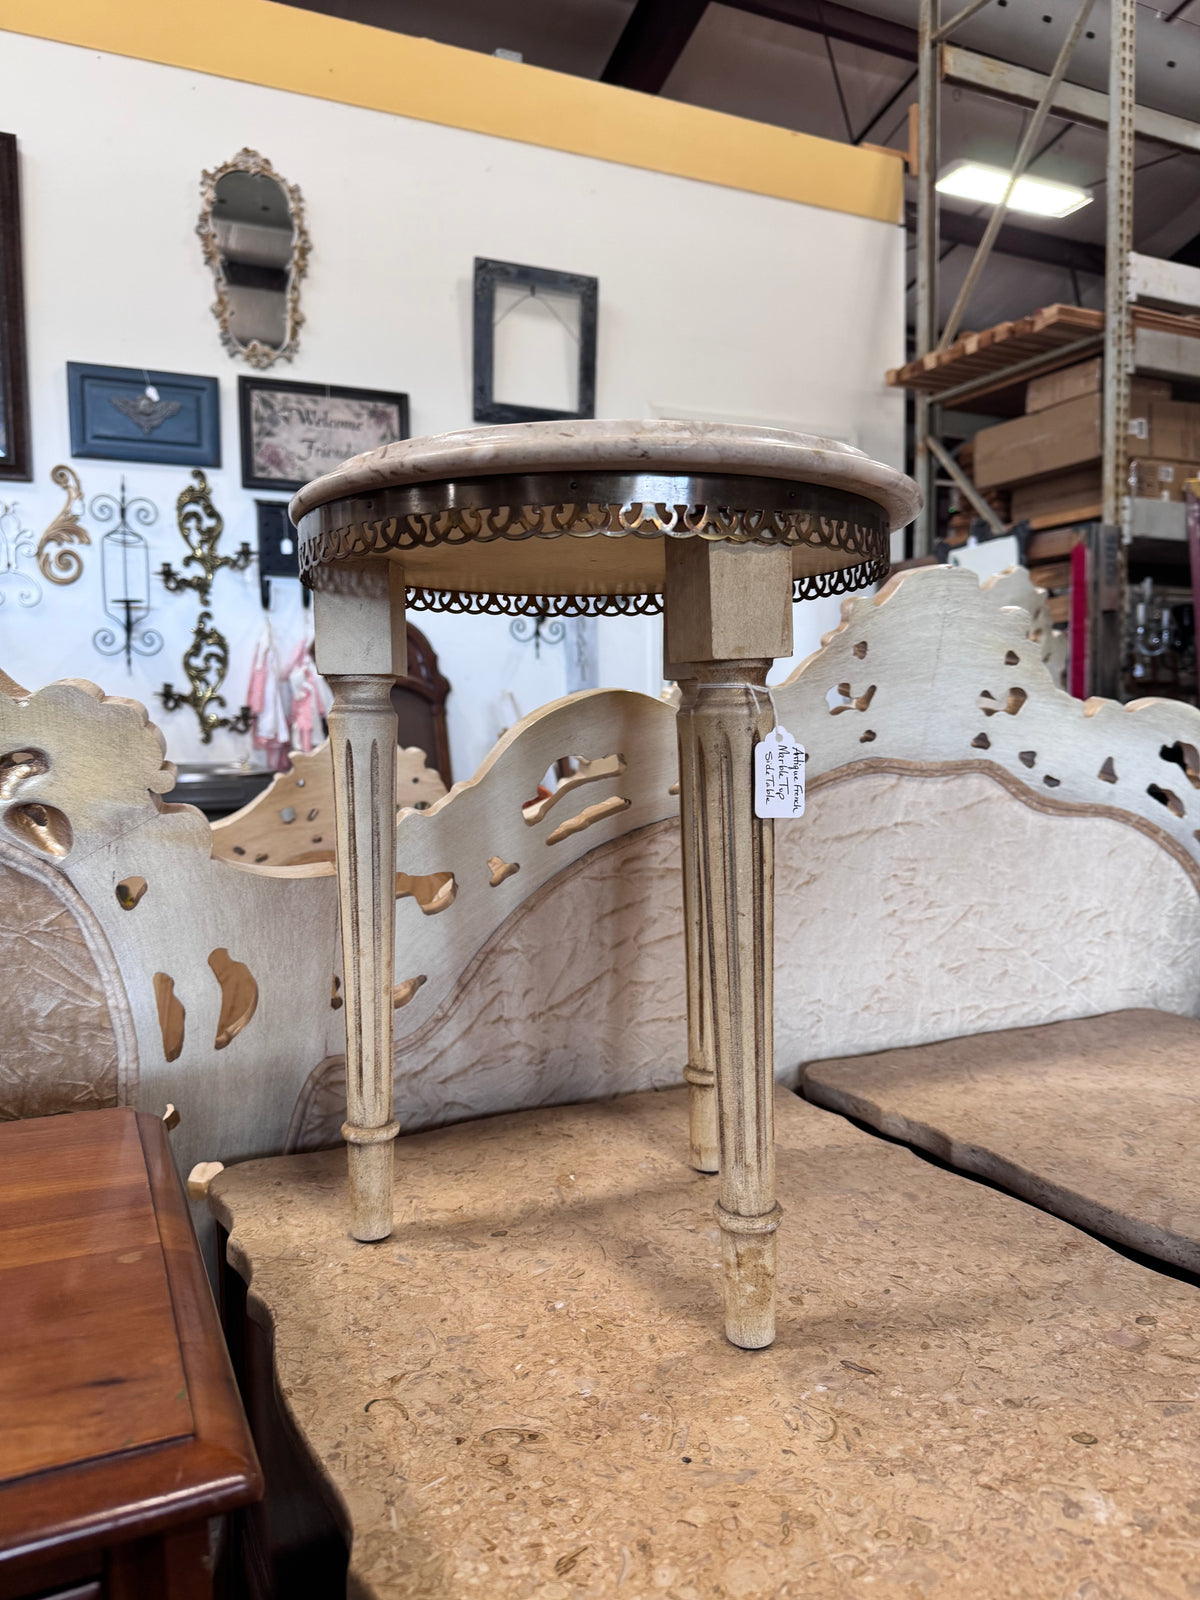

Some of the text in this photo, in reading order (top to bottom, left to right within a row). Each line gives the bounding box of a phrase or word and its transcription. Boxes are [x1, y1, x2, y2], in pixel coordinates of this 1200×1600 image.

[290, 407, 363, 432] Welcome
[765, 751, 775, 805] Side Table
[775, 744, 791, 801] Marble Top
[788, 746, 805, 813] Antique French
